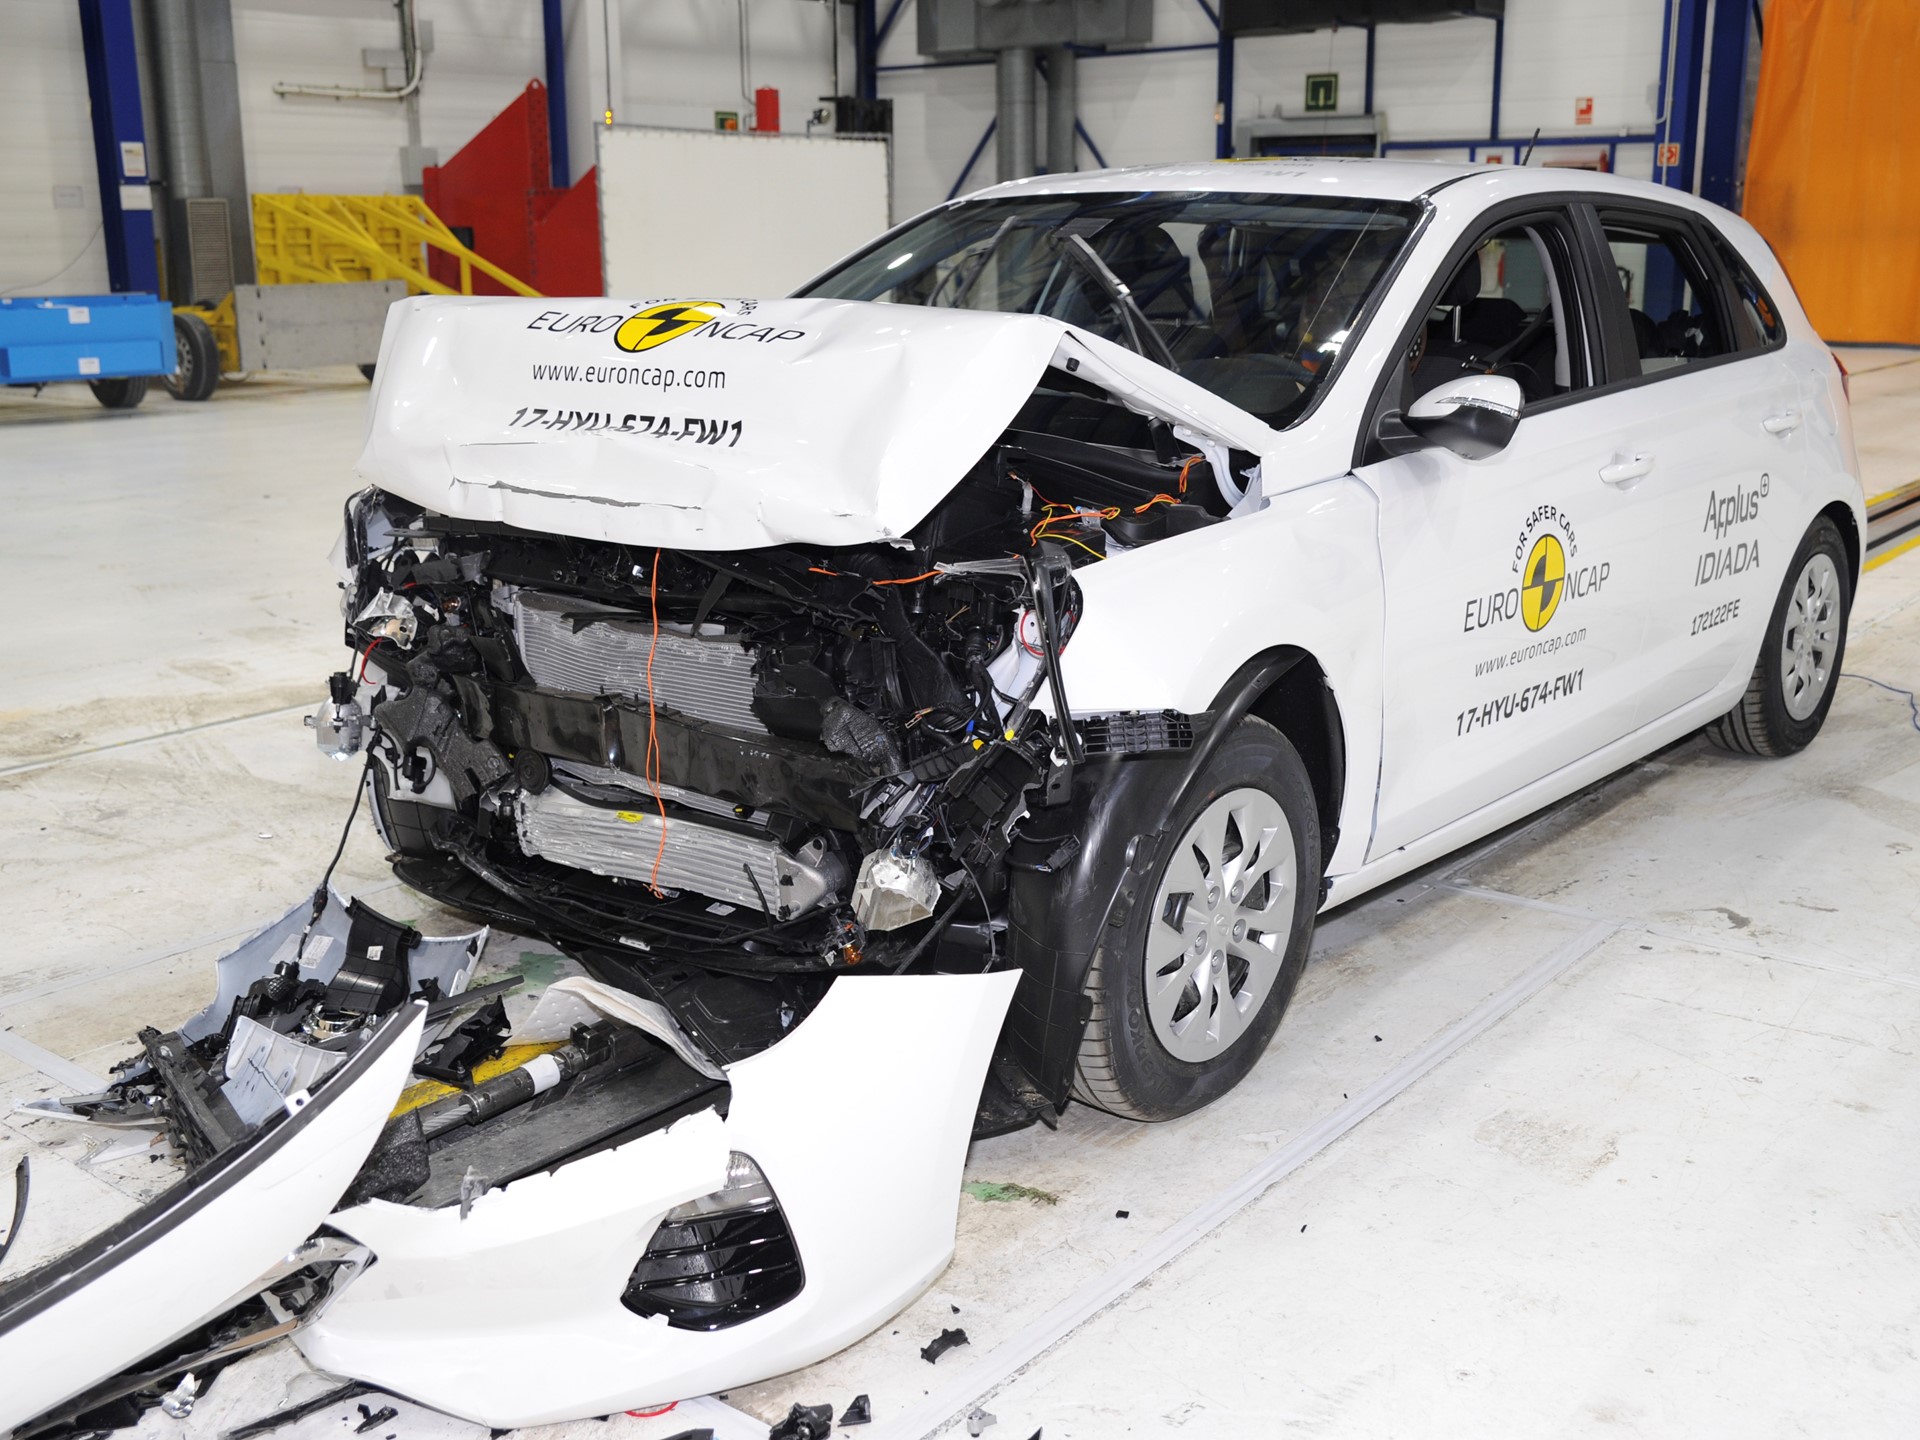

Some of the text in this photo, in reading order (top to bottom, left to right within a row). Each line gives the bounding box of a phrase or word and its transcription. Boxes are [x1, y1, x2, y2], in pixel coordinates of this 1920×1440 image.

[526, 310, 806, 344] EURO NCAP
[532, 364, 726, 393] www.euroncap.com
[508, 406, 743, 448] 17-HYU-674-FW1
[1511, 504, 1578, 574] FOR SAFER CARS
[1694, 539, 1760, 587] IDIADA
[1463, 561, 1611, 633] EURO NCAP
[1690, 598, 1741, 637] 172122FE
[1475, 627, 1587, 678] www.euroncap.com
[1456, 667, 1585, 737] 17-HYU-674-FW1
